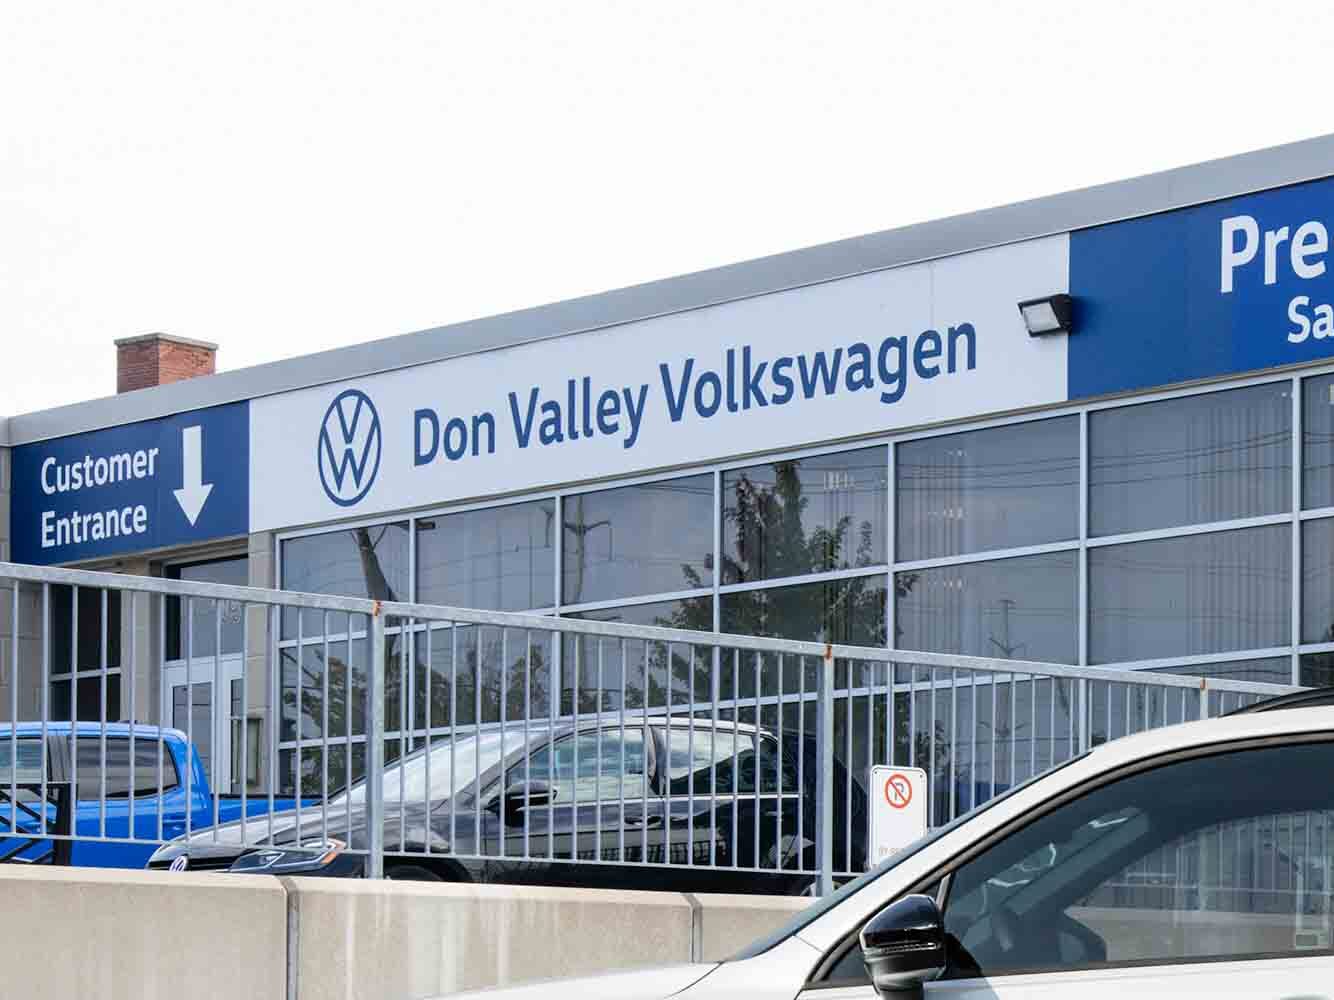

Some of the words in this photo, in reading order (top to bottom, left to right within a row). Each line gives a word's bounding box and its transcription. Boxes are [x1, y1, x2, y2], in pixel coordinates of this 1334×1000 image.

[413, 408, 496, 467] Don
[507, 375, 649, 449] Valley
[659, 322, 977, 423] Volkswagen
[41, 447, 159, 495] Customer
[41, 504, 148, 548] Entrance
